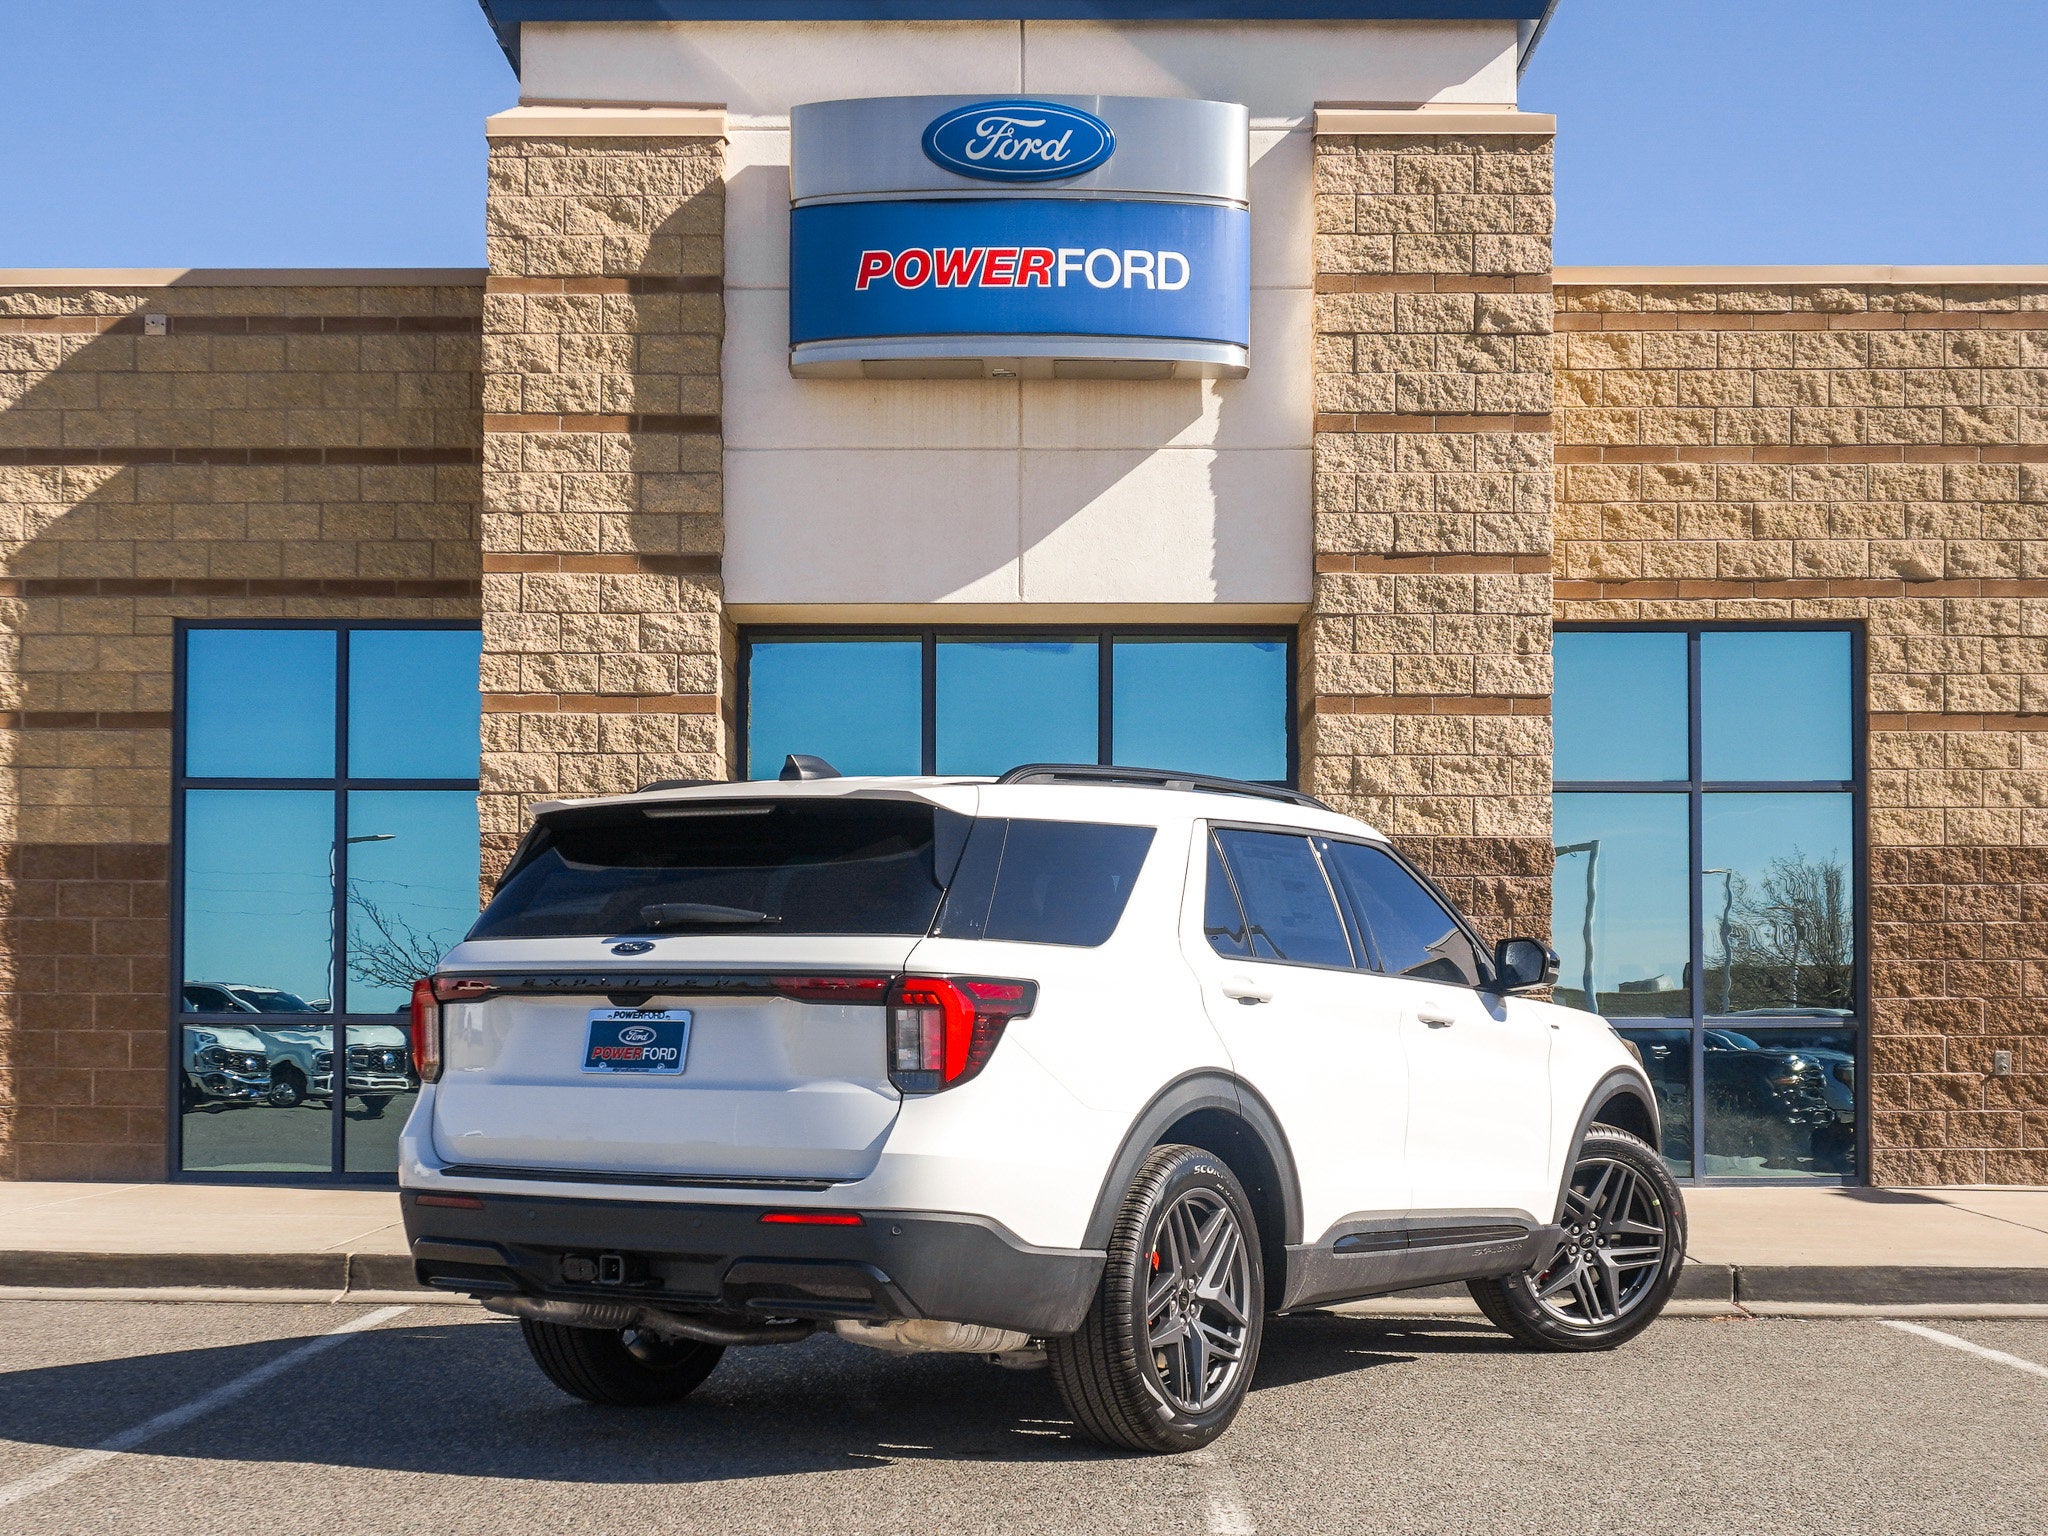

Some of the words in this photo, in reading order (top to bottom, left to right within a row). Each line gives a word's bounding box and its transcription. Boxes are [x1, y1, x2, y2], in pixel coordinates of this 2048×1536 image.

[965, 116, 1073, 163] Ford
[855, 246, 1191, 291] POWERFORD
[625, 1029, 650, 1041] Ford
[590, 1046, 678, 1061] POWERFORD
